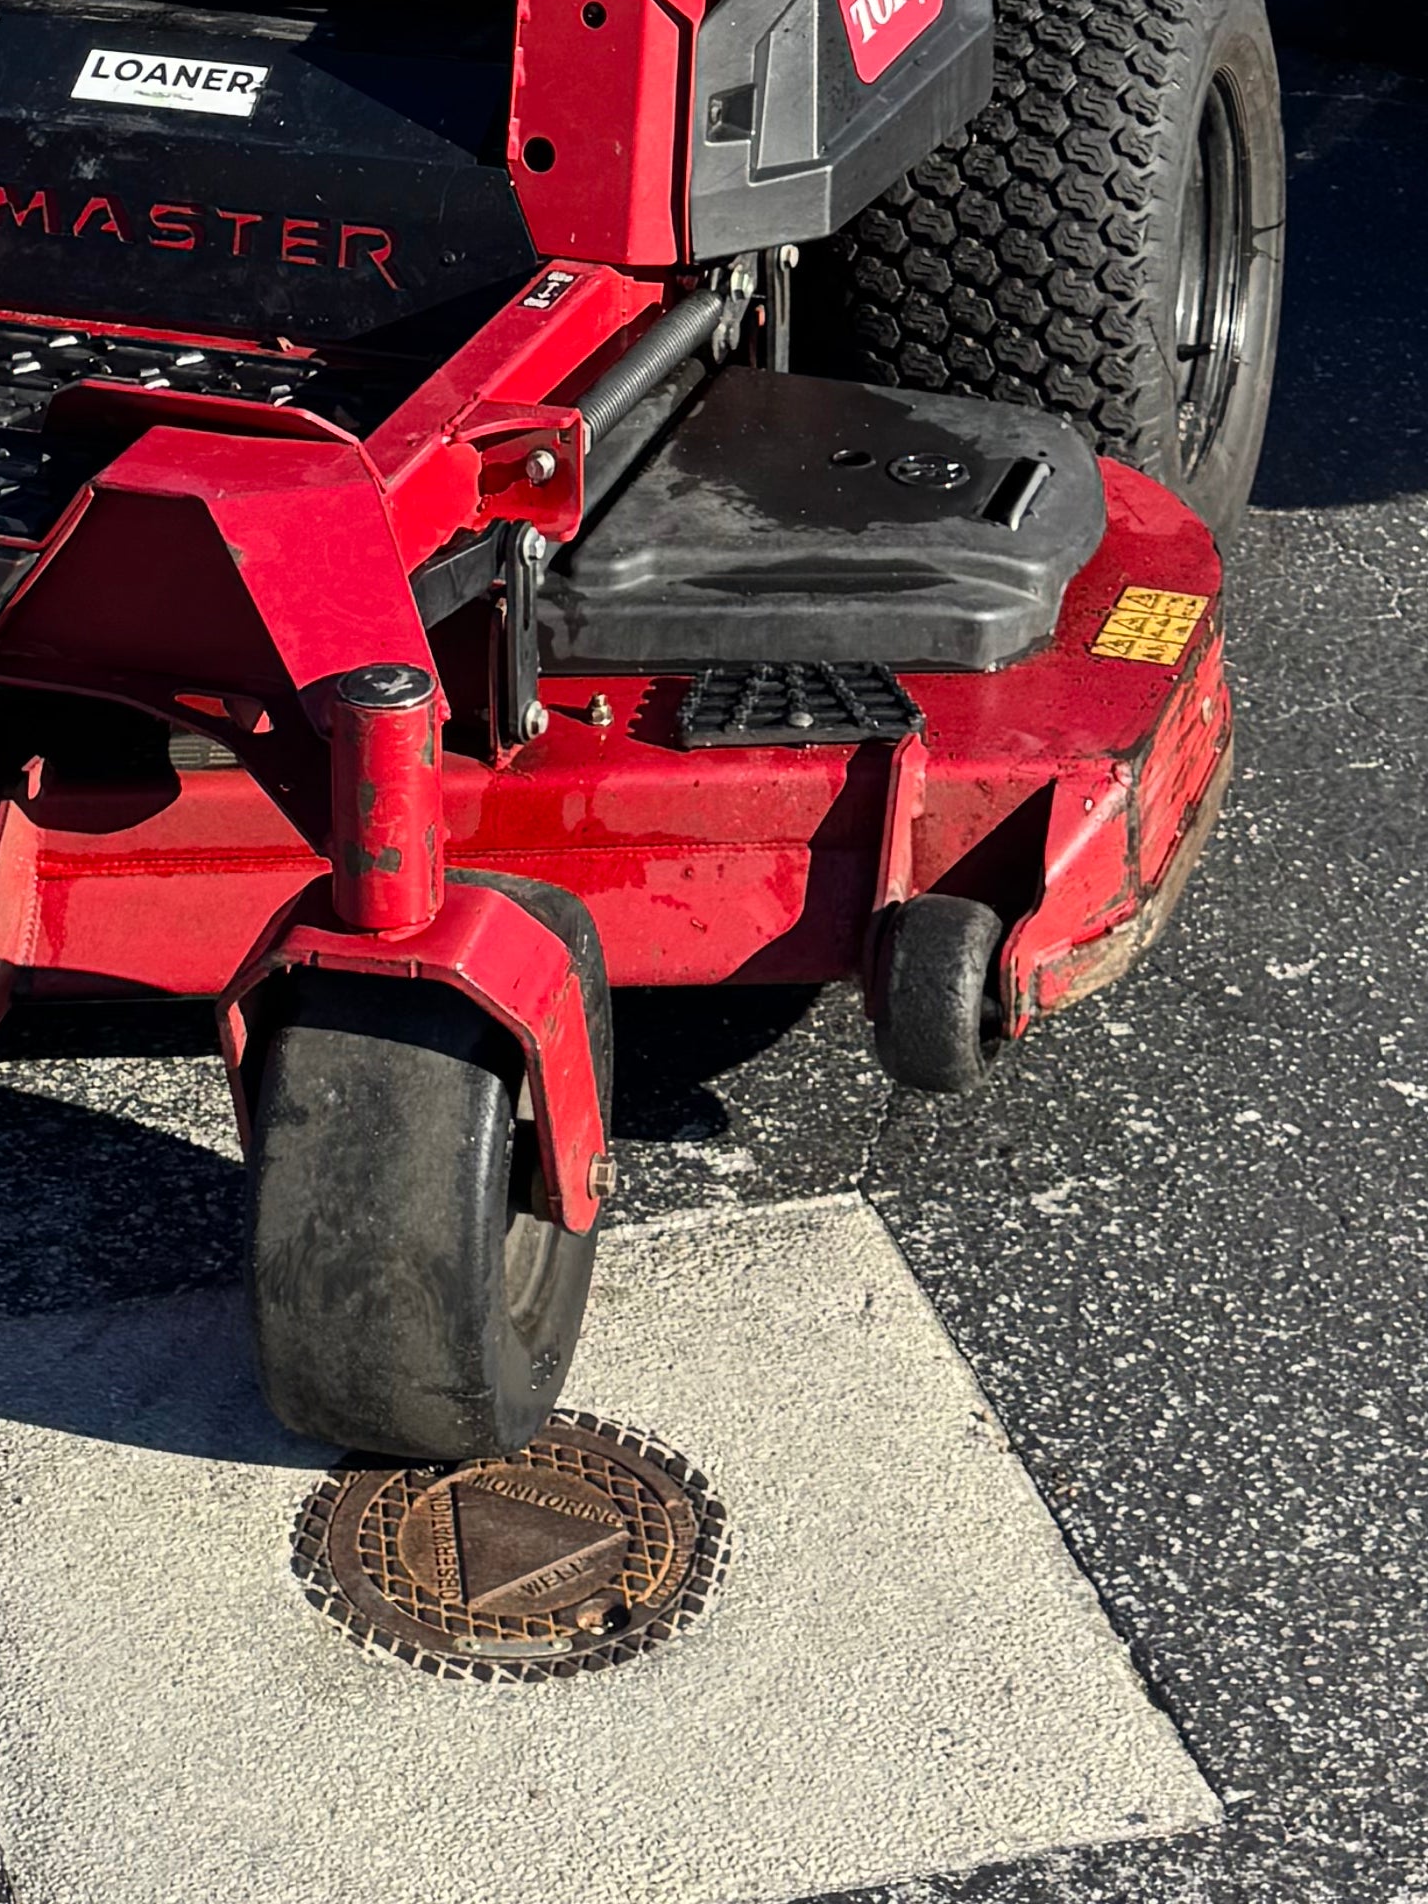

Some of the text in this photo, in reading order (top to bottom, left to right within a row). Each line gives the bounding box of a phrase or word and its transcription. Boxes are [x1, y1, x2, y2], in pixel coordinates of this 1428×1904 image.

[91, 56, 254, 94] LOANER
[472, 1472, 623, 1529] MONITORING
[429, 1491, 460, 1600] OBSERVATION
[519, 1557, 594, 1598] WELL
